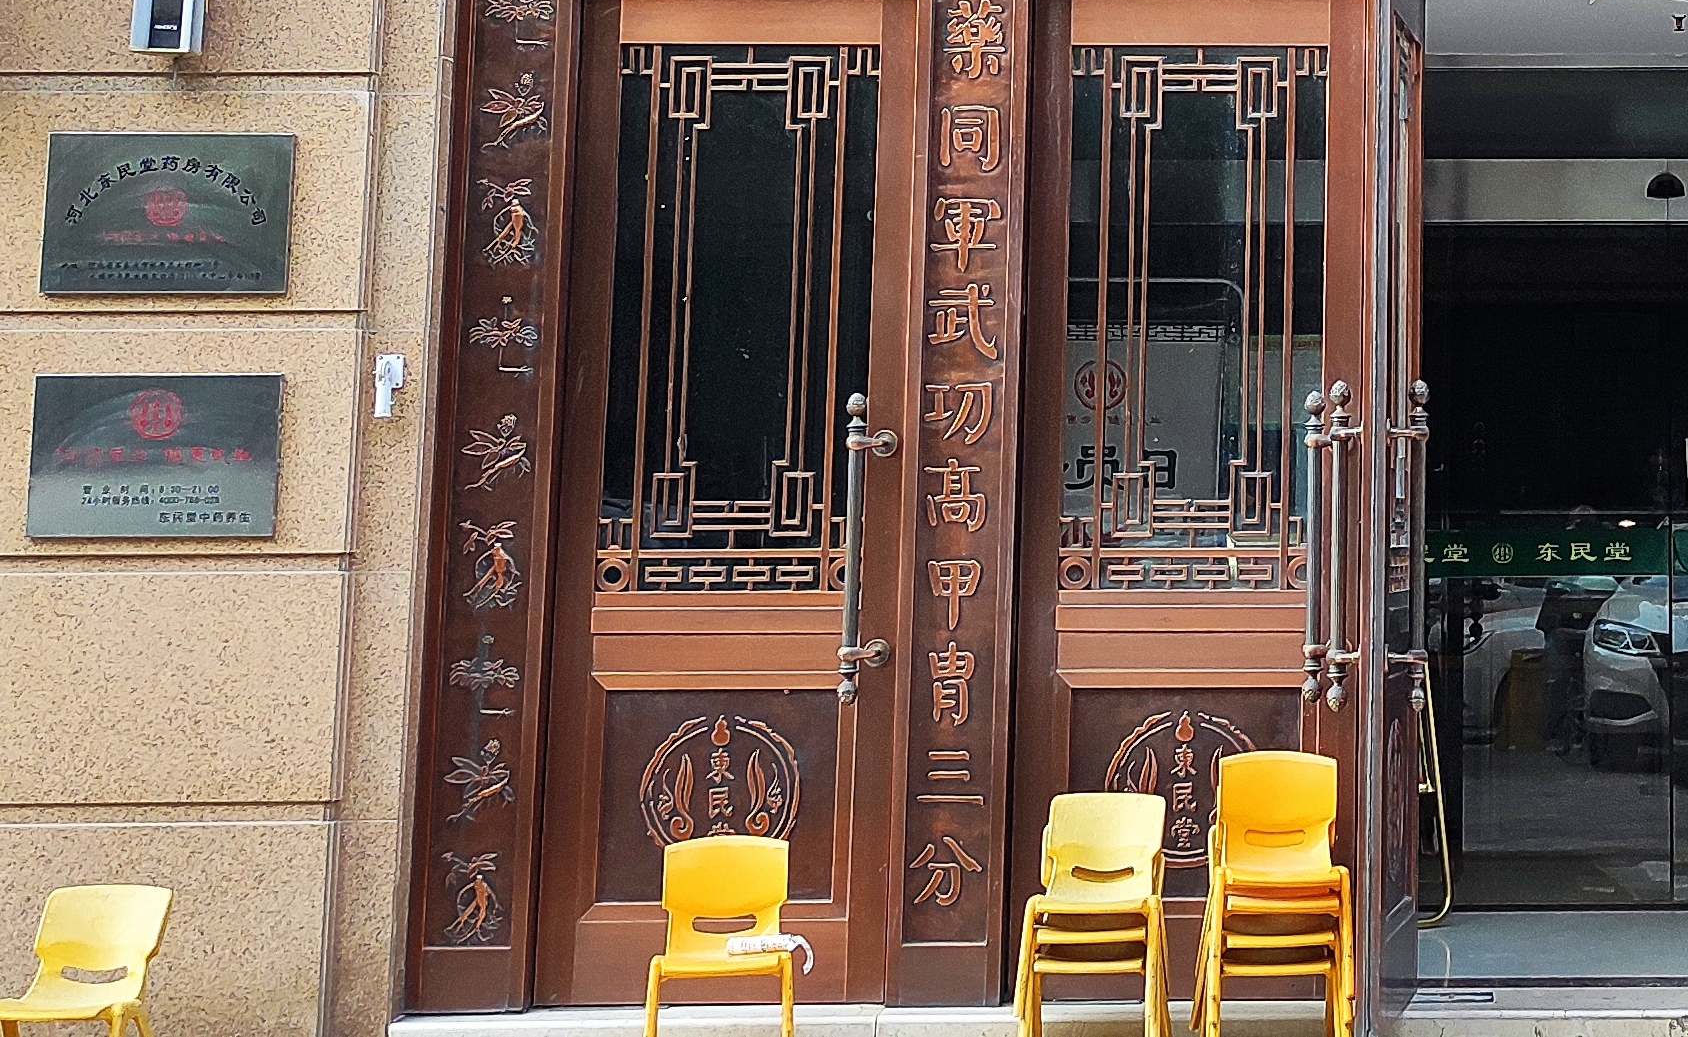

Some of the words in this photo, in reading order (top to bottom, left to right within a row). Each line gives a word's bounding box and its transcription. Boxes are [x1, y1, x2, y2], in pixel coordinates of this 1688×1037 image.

[64, 155, 268, 226] 河北东民堂药房有限公司
[1535, 541, 1633, 563] 东民堂
[1170, 744, 1200, 848] 東民堂
